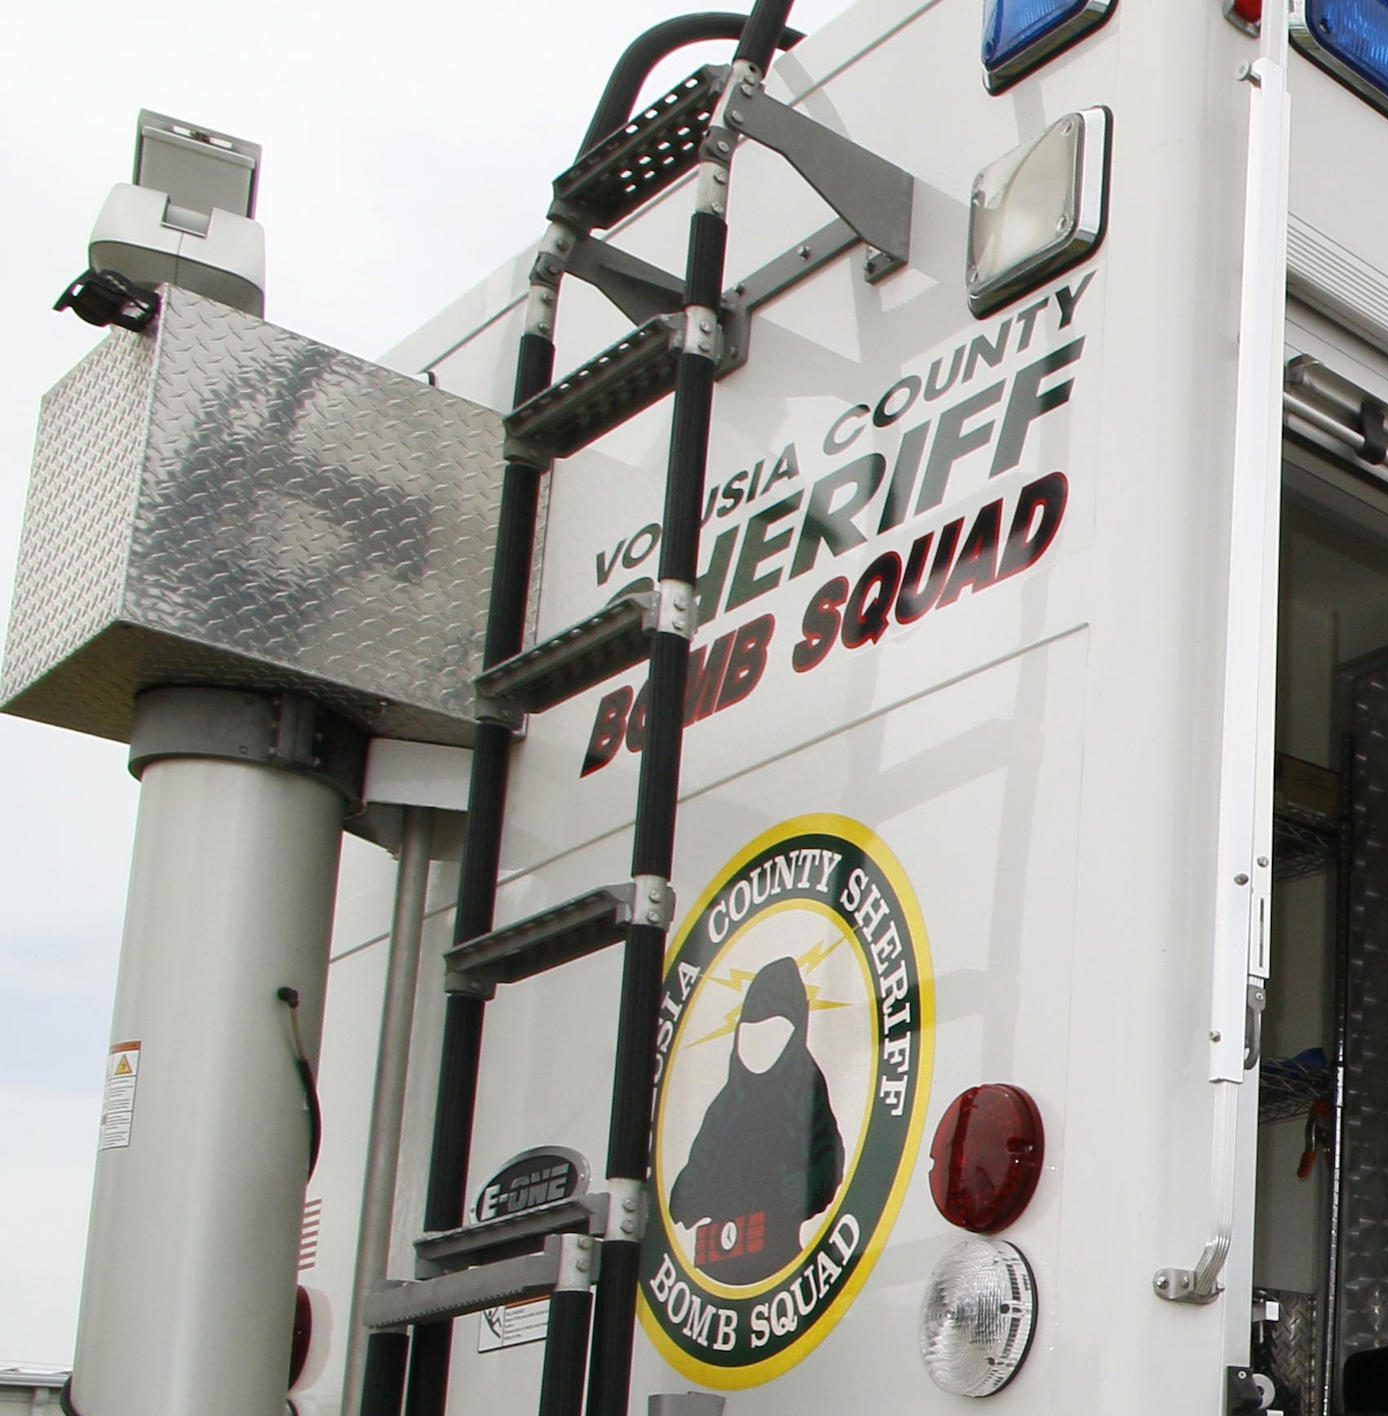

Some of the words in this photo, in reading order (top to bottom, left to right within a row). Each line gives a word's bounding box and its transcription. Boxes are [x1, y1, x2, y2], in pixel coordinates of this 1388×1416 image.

[596, 442, 799, 586] VOUSIA
[823, 270, 1097, 456] COUNTY
[792, 471, 1069, 674] SQUAD
[708, 849, 842, 943] COUNTY
[840, 868, 911, 1116] SHERIFF
[481, 1163, 570, 1221] E-ONE
[650, 1253, 738, 1351] BOMB
[751, 1213, 860, 1348] SQUAD
